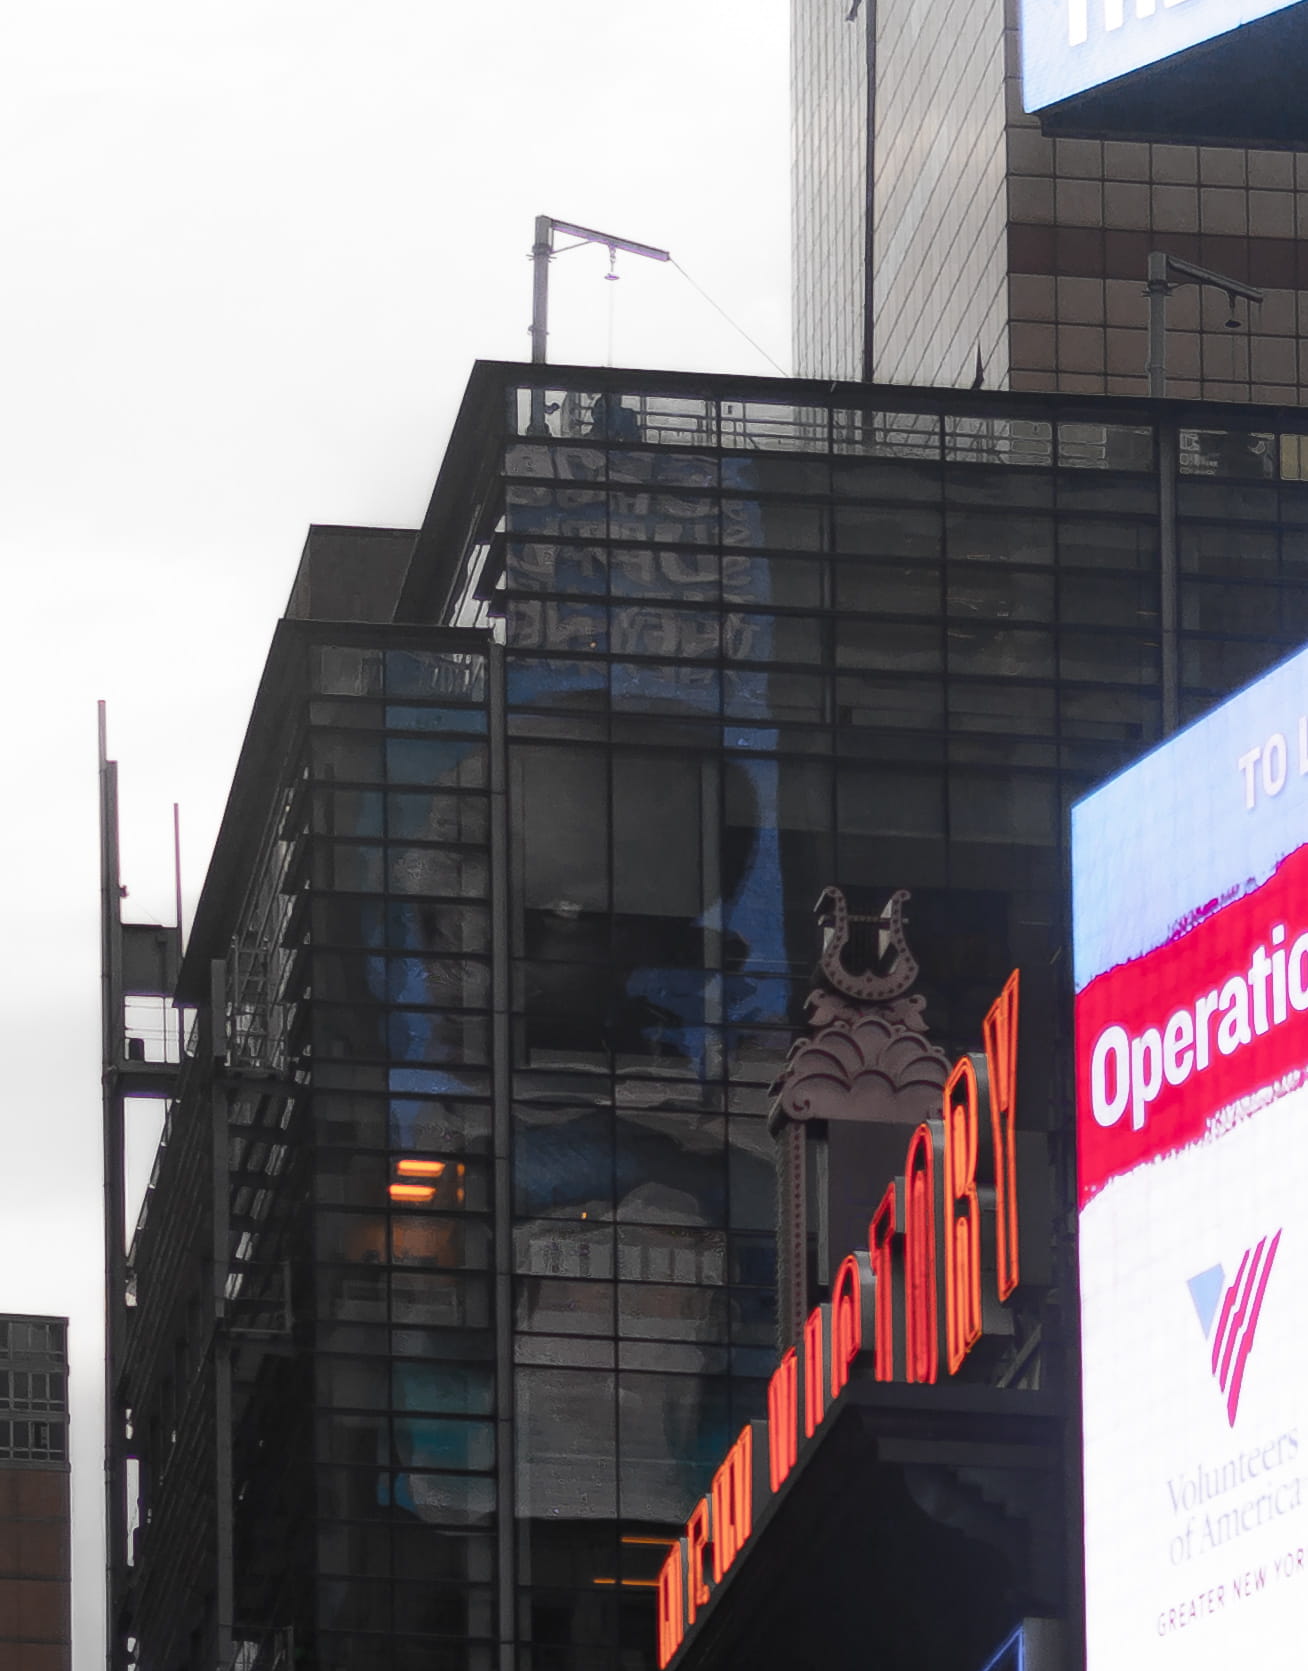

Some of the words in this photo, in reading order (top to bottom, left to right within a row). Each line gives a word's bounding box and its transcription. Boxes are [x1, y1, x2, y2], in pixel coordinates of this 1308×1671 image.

[1238, 732, 1288, 811] TO
[1168, 1427, 1300, 1516] Volunteers
[1199, 1476, 1302, 1553] America
[1157, 1585, 1225, 1637] GREATER
